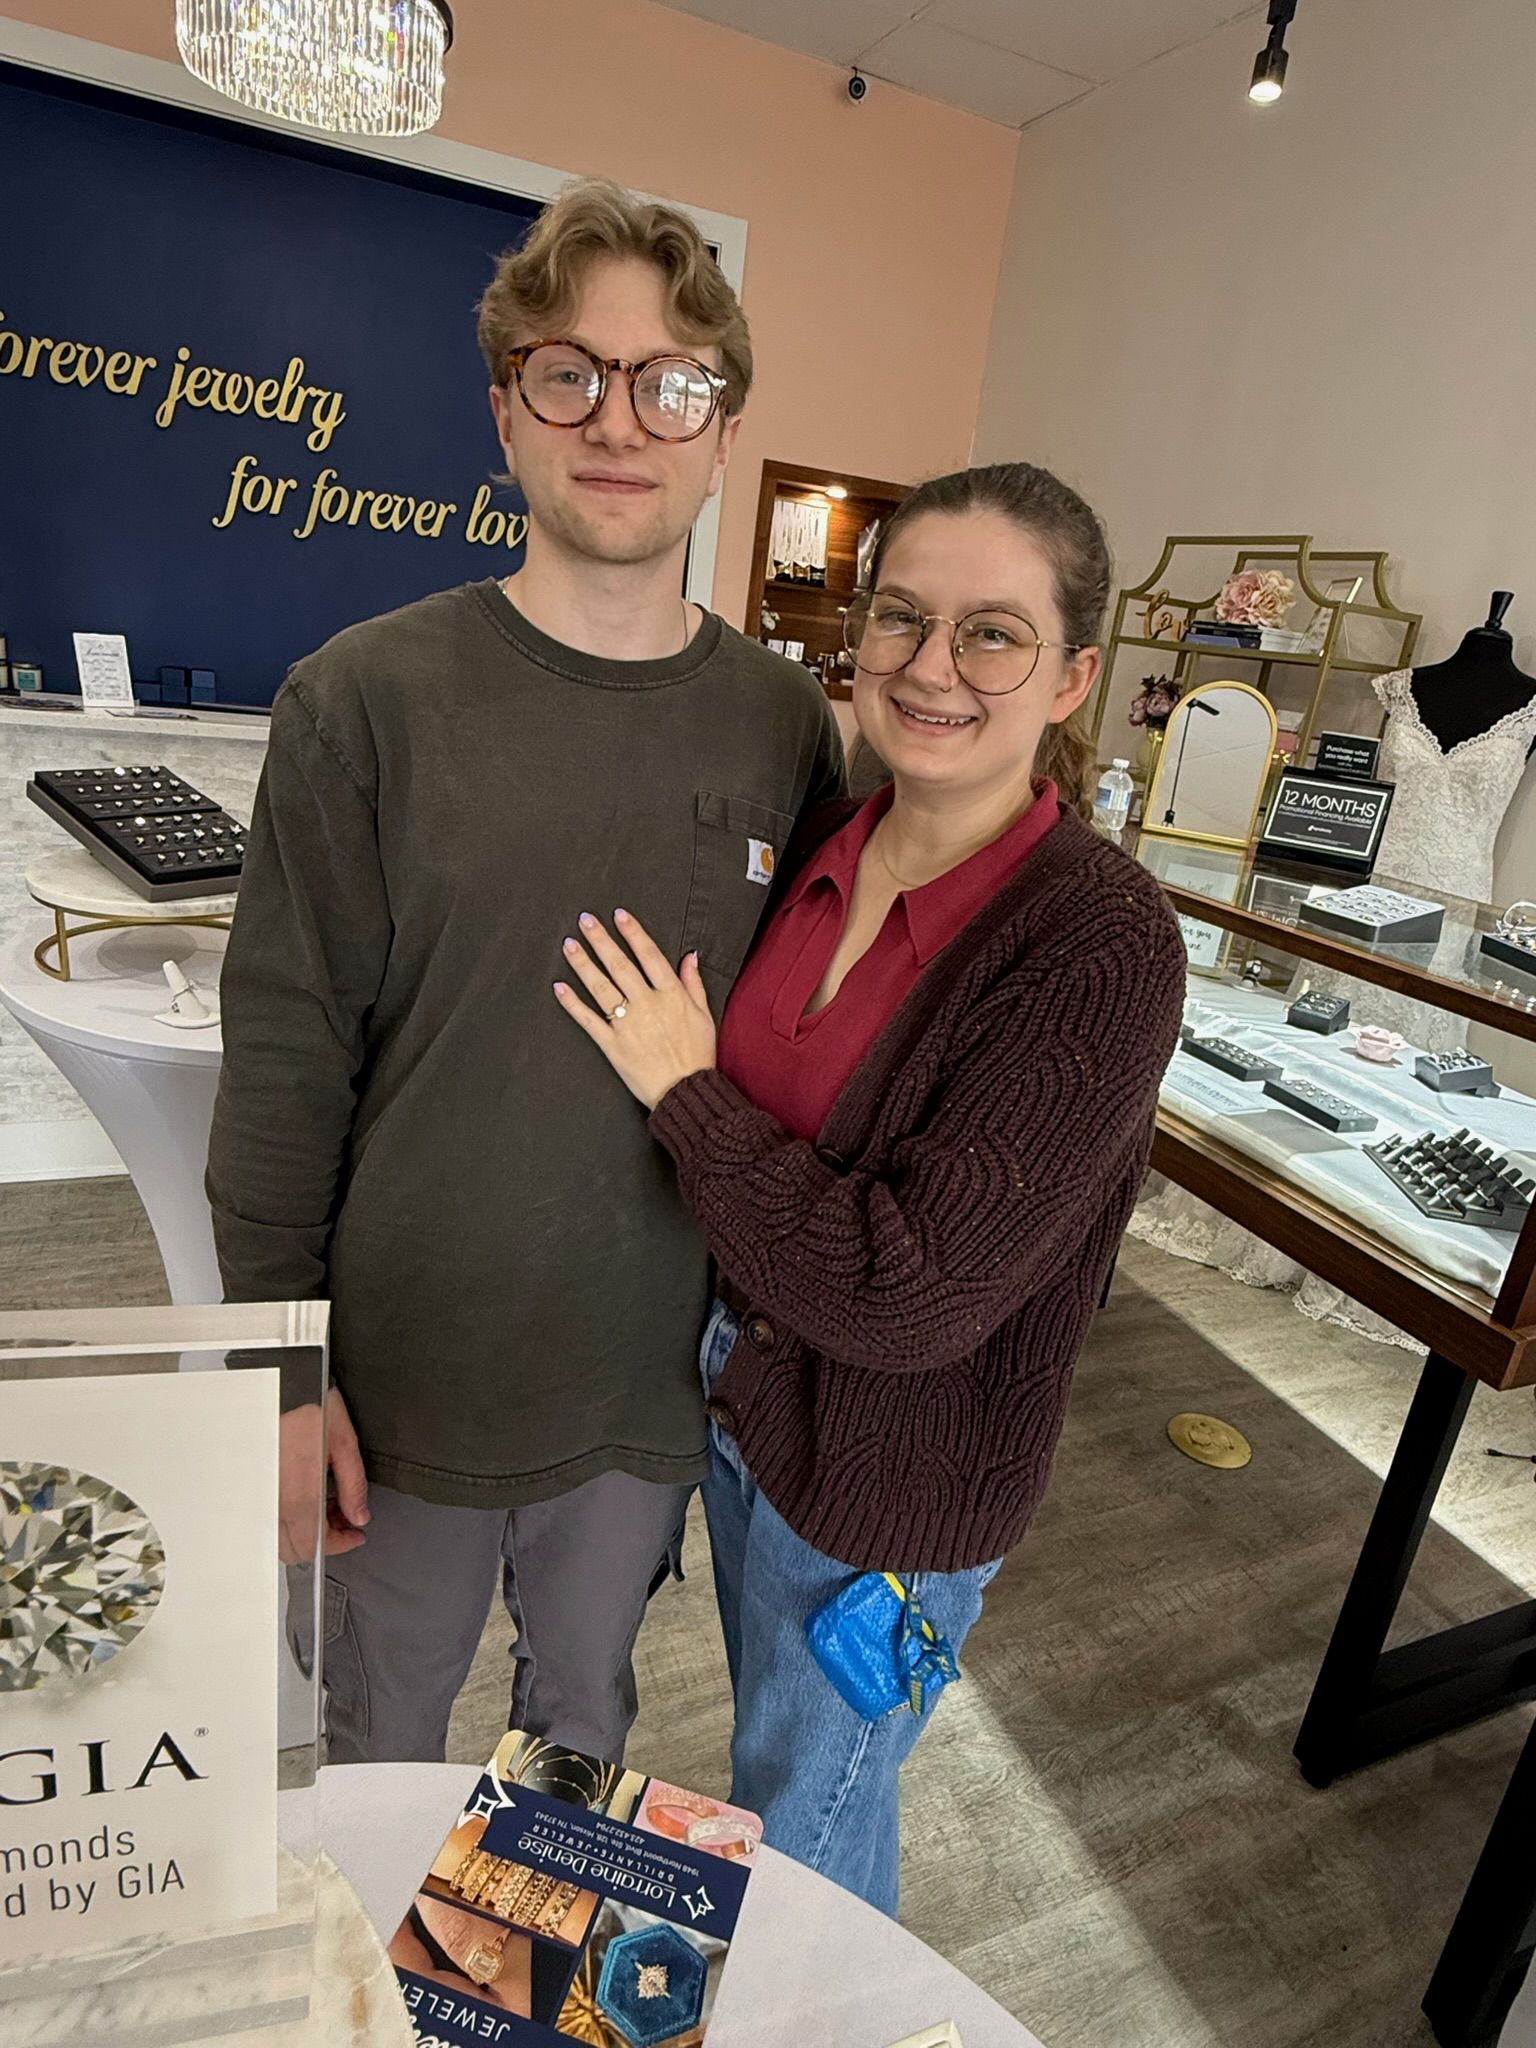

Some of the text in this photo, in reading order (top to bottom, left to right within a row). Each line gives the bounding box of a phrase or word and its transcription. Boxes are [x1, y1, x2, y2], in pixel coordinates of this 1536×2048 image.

[0, 311, 346, 451] orever jewelry
[212, 456, 297, 528] for
[293, 468, 457, 538] forever
[1326, 744, 1354, 755] Purchase
[1280, 804, 1314, 815] Promotional
[1314, 810, 1344, 821] Financing
[1284, 789, 1377, 818] 12 MONTHS
[558, 1820, 567, 1828] TN
[518, 1837, 675, 1907] Lorraine Denise
[643, 1851, 681, 1870] Northpoint
[683, 1865, 699, 1876] 1948
[49, 1878, 96, 1915] by
[118, 1859, 185, 1899] GIA
